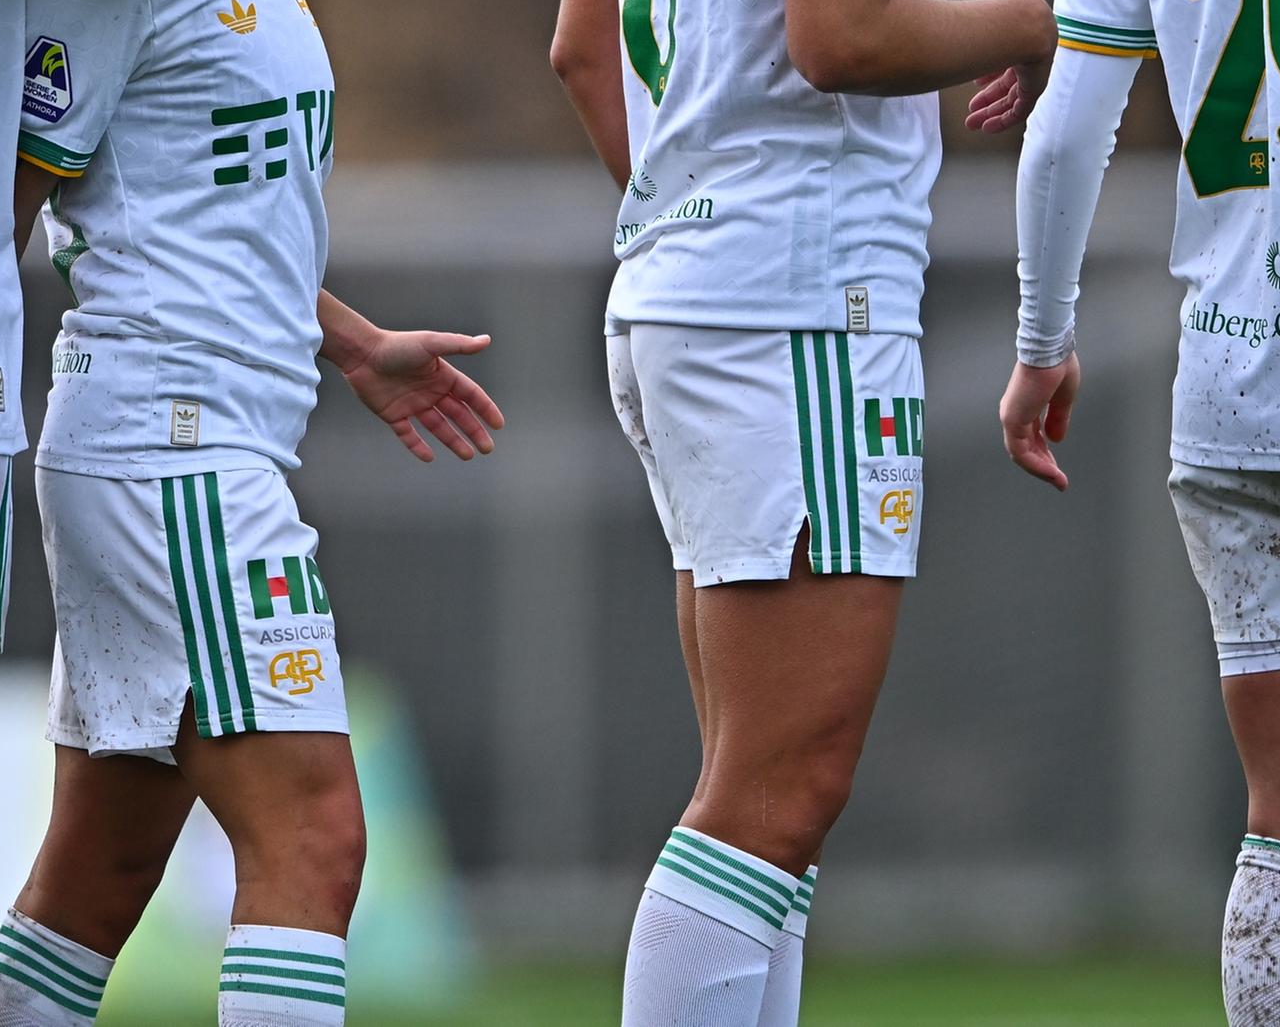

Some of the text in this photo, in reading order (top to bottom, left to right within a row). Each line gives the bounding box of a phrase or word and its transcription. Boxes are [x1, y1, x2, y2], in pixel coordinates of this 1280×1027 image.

[24, 85, 58, 104] WOMEN
[25, 79, 58, 97] SERIE A
[26, 100, 57, 118] ATHORA
